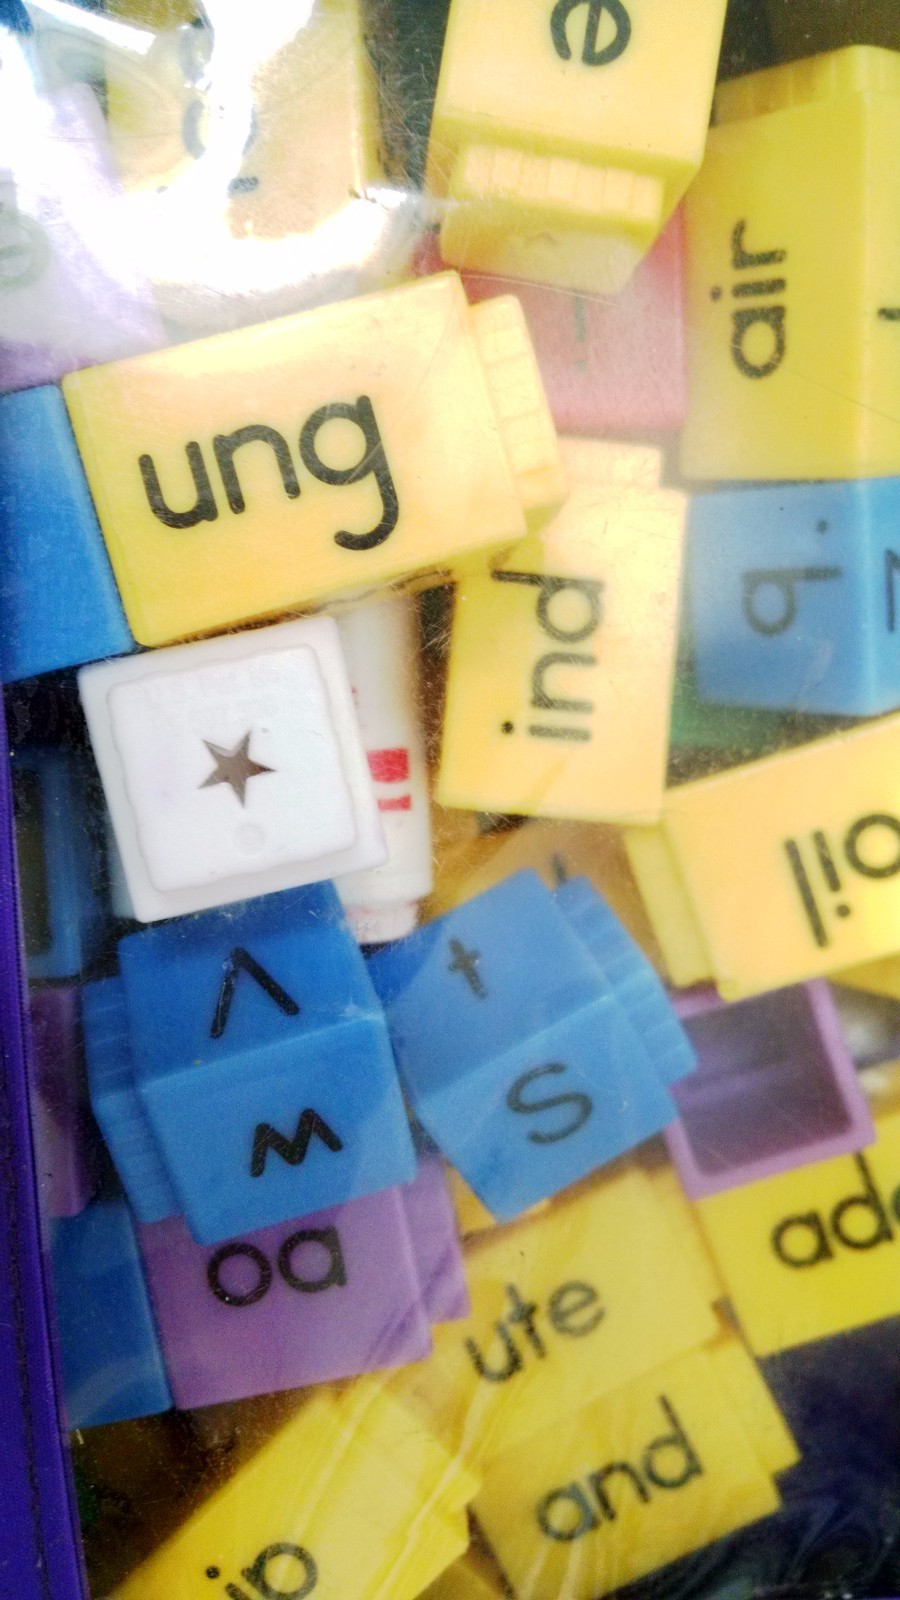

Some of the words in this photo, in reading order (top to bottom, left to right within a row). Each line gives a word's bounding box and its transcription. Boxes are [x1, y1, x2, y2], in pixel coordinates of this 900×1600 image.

[709, 219, 787, 379] air
[138, 395, 399, 550] ung
[491, 568, 605, 744] ind
[783, 814, 900, 948] oil
[447, 939, 488, 999] t
[206, 1225, 348, 1307] oa
[771, 1153, 900, 1269] ad
[465, 1281, 606, 1382] ute
[536, 1394, 705, 1543] and
